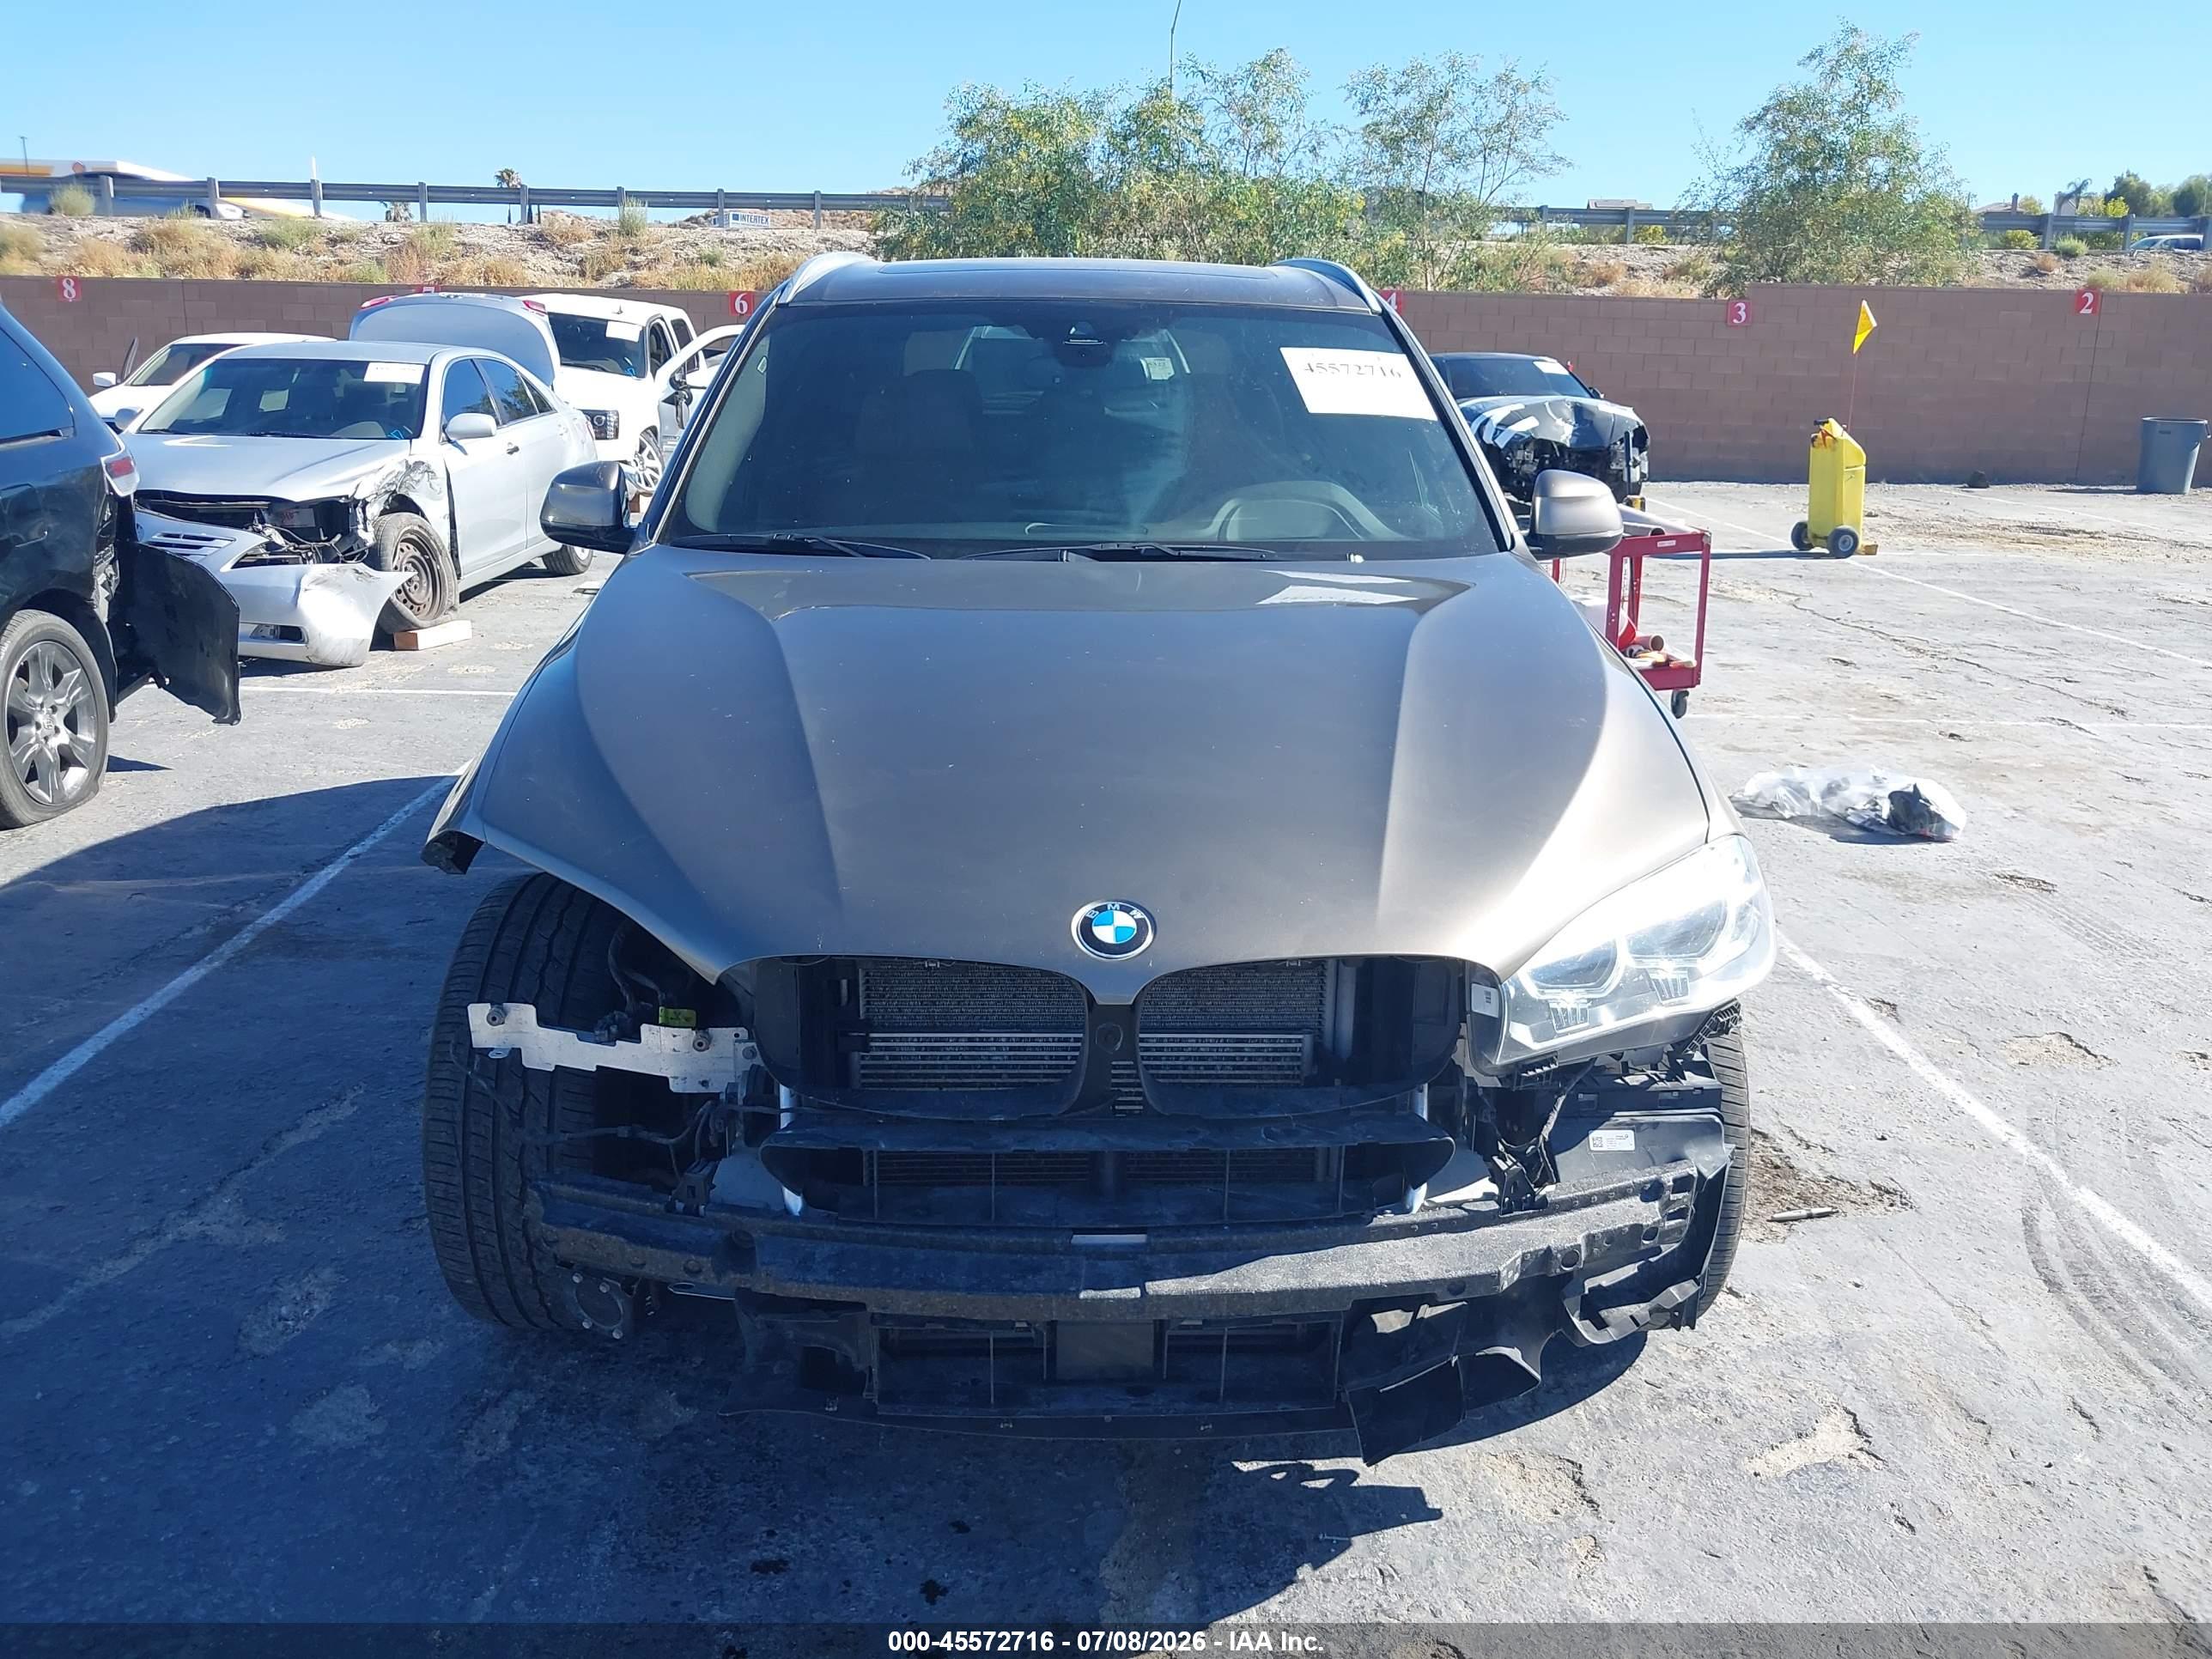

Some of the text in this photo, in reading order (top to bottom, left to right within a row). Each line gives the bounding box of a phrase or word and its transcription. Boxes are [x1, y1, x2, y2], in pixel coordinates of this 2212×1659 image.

[739, 213, 769, 225] INTERTEX
[62, 277, 76, 299] 8
[734, 292, 748, 314] 6
[1733, 302, 1746, 323] 3
[2080, 292, 2094, 313] 2
[1304, 362, 1402, 379] 45572716
[1085, 903, 1145, 919] BMW
